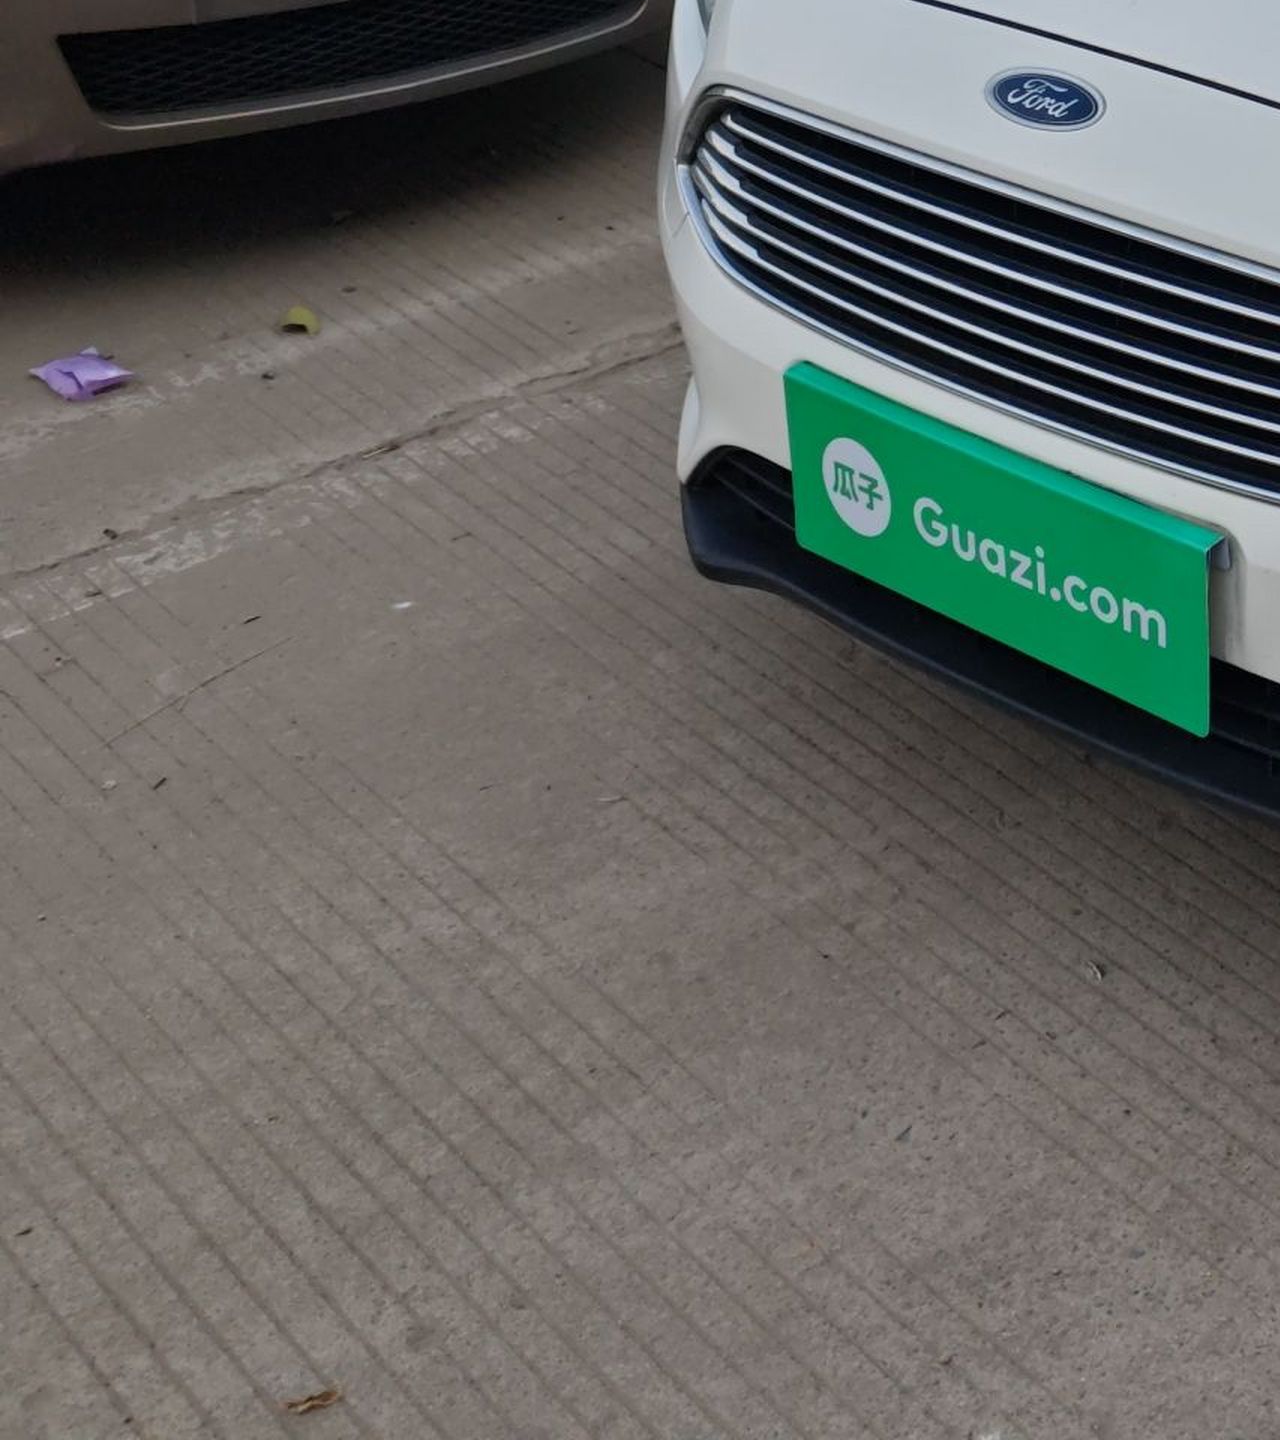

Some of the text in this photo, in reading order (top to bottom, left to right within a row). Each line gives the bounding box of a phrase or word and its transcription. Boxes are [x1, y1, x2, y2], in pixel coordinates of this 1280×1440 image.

[1007, 78, 1079, 118] Ford
[832, 460, 884, 511] 瓜子
[912, 496, 1168, 649] Guazi.com
